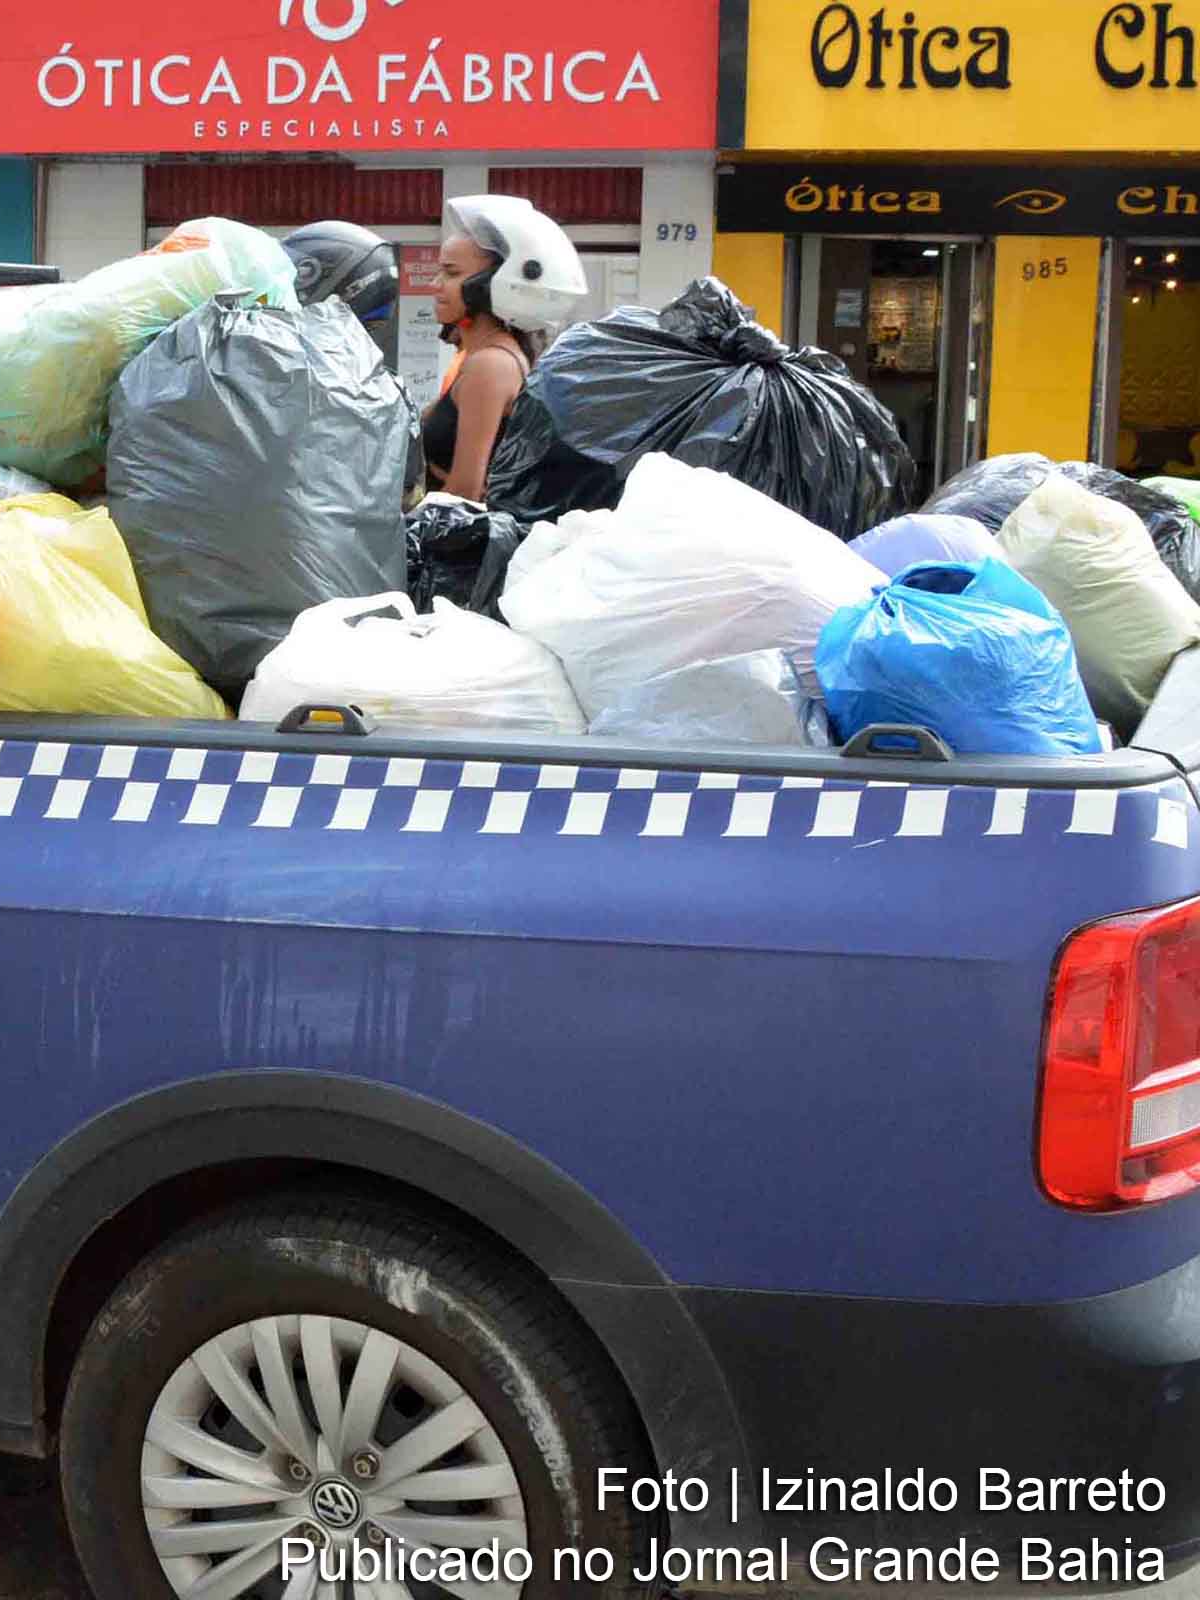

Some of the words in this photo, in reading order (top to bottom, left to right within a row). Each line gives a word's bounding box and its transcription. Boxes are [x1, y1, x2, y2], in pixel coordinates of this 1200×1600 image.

[37, 43, 242, 107] ÓTICA
[266, 55, 353, 105] DA
[377, 37, 661, 103] FÁBRICA
[194, 118, 449, 137] ESPECIALISTA
[785, 177, 942, 213] Ótica
[656, 222, 698, 241] 979
[1021, 257, 1069, 282] 985
